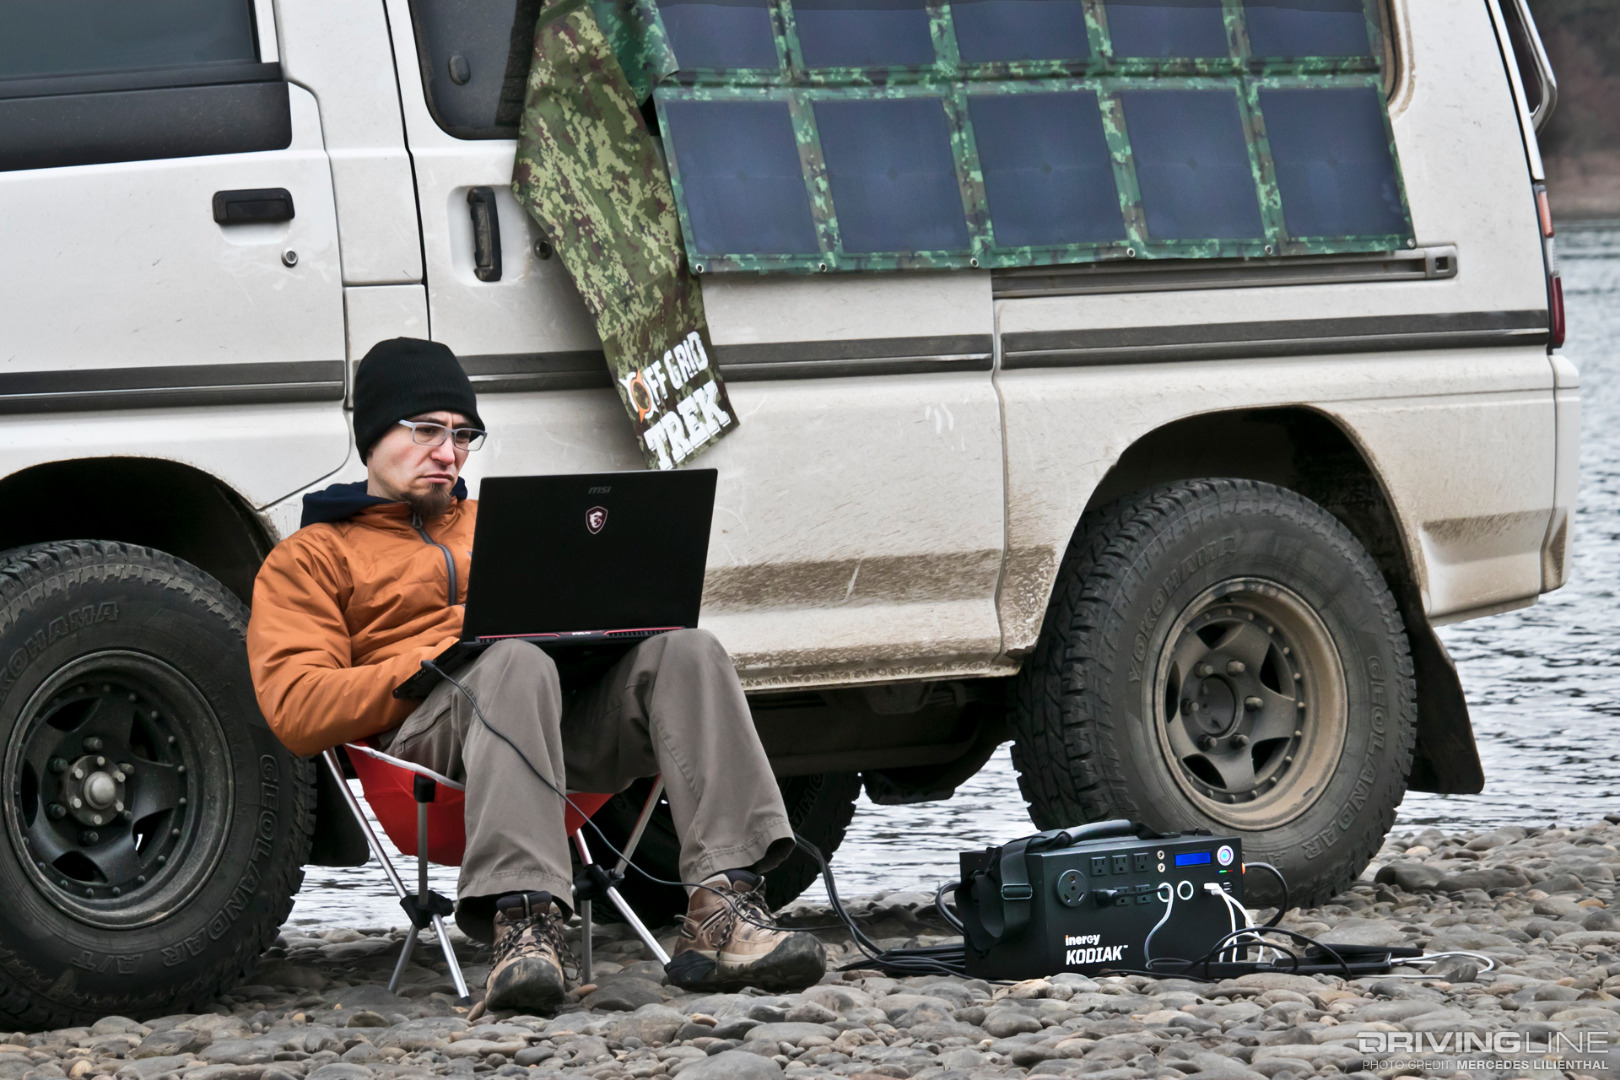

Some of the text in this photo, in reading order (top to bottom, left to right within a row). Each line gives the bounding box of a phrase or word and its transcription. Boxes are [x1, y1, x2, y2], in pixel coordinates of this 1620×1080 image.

[619, 331, 709, 421] OFF GRID
[643, 379, 732, 470] TREK
[1128, 535, 1241, 682] YOKOHAMA
[1301, 655, 1387, 861] GEOLANDAR
[162, 754, 280, 968] GEOLANDAR
